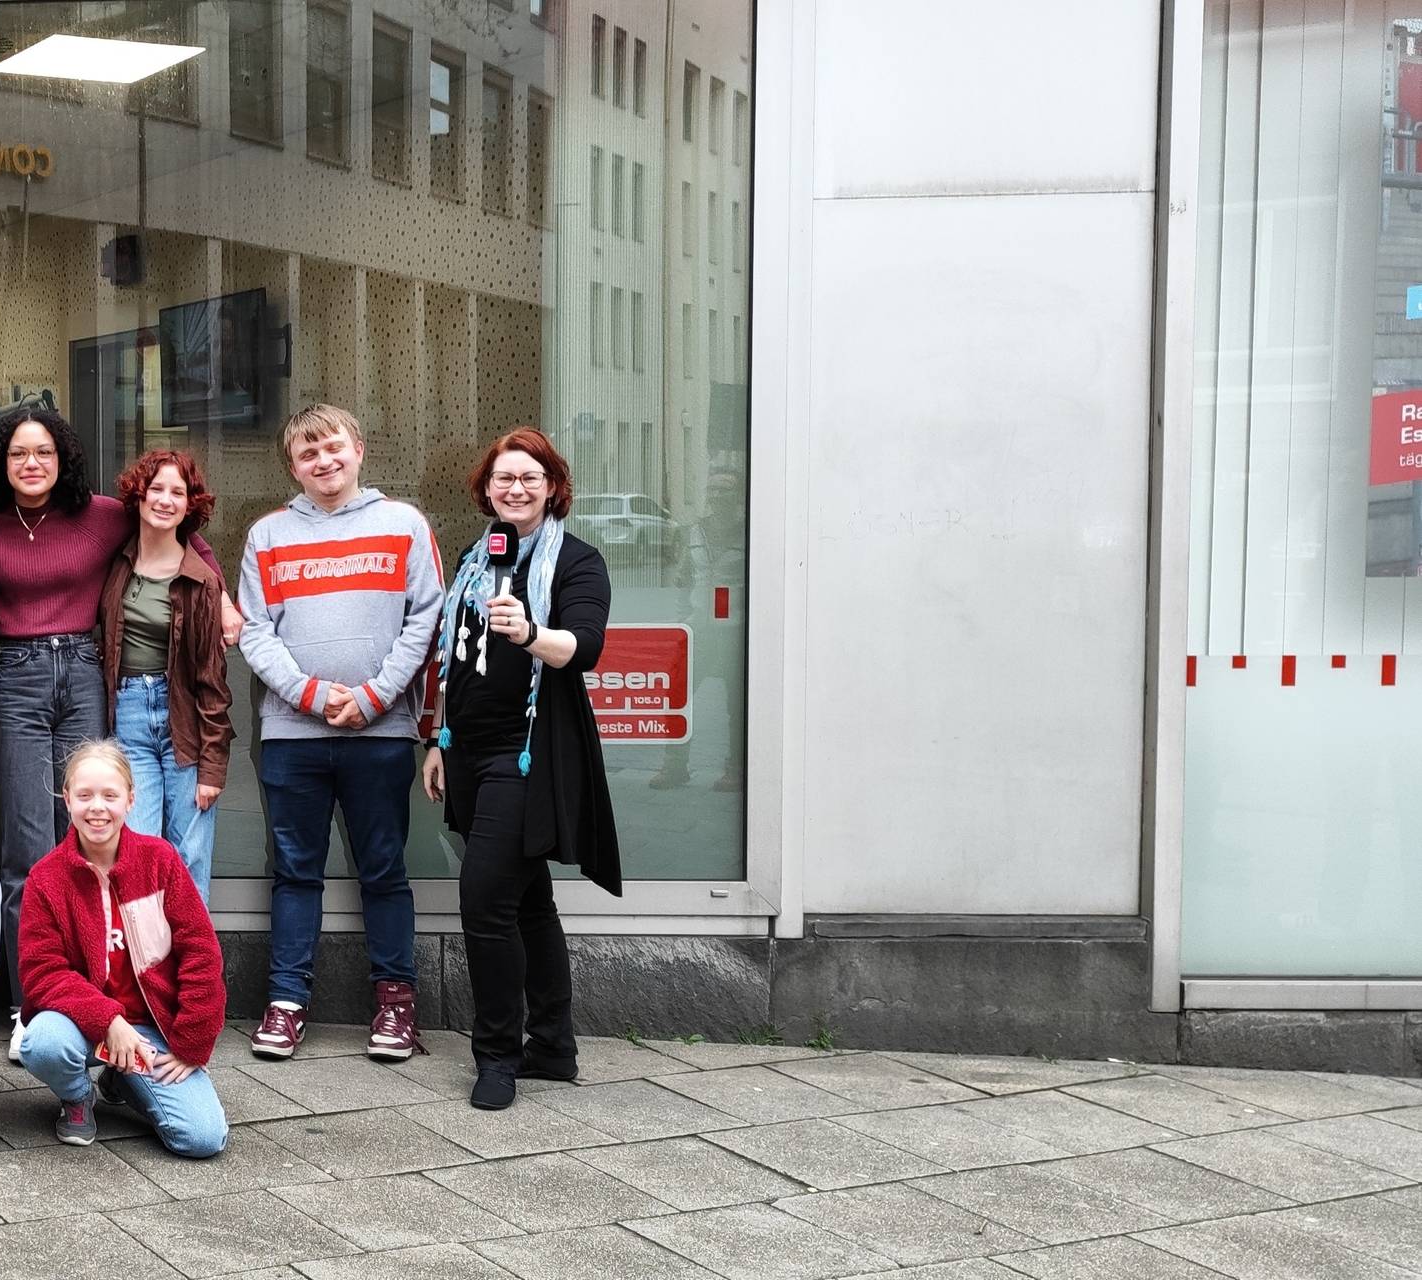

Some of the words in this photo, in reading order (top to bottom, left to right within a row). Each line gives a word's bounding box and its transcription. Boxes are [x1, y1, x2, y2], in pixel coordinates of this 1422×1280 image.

[581, 671, 671, 690] ssen
[633, 696, 662, 705] 105.0
[596, 721, 633, 734] este
[638, 719, 671, 734] Mix.
